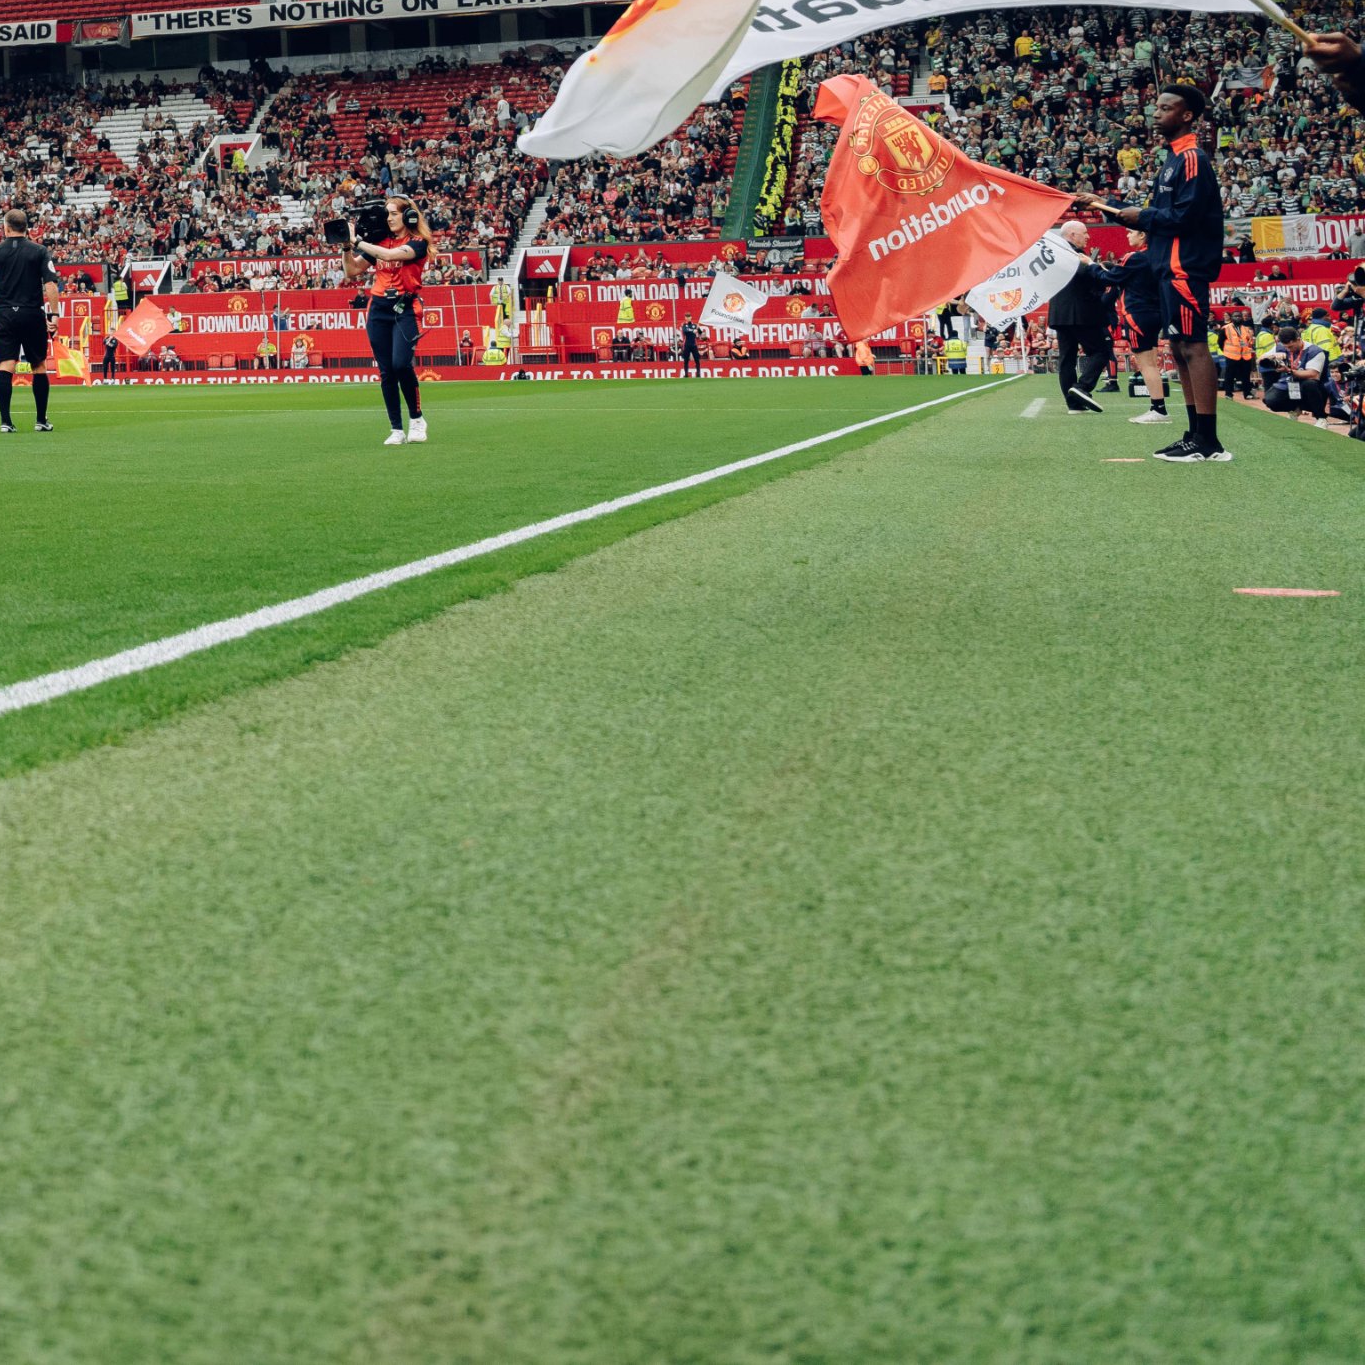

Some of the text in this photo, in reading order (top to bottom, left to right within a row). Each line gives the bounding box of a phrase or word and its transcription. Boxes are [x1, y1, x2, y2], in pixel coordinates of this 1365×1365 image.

[136, 6, 253, 32] "THERE'S
[198, 314, 268, 334] DOWNLOAD
[751, 322, 806, 344] OFFICIA
